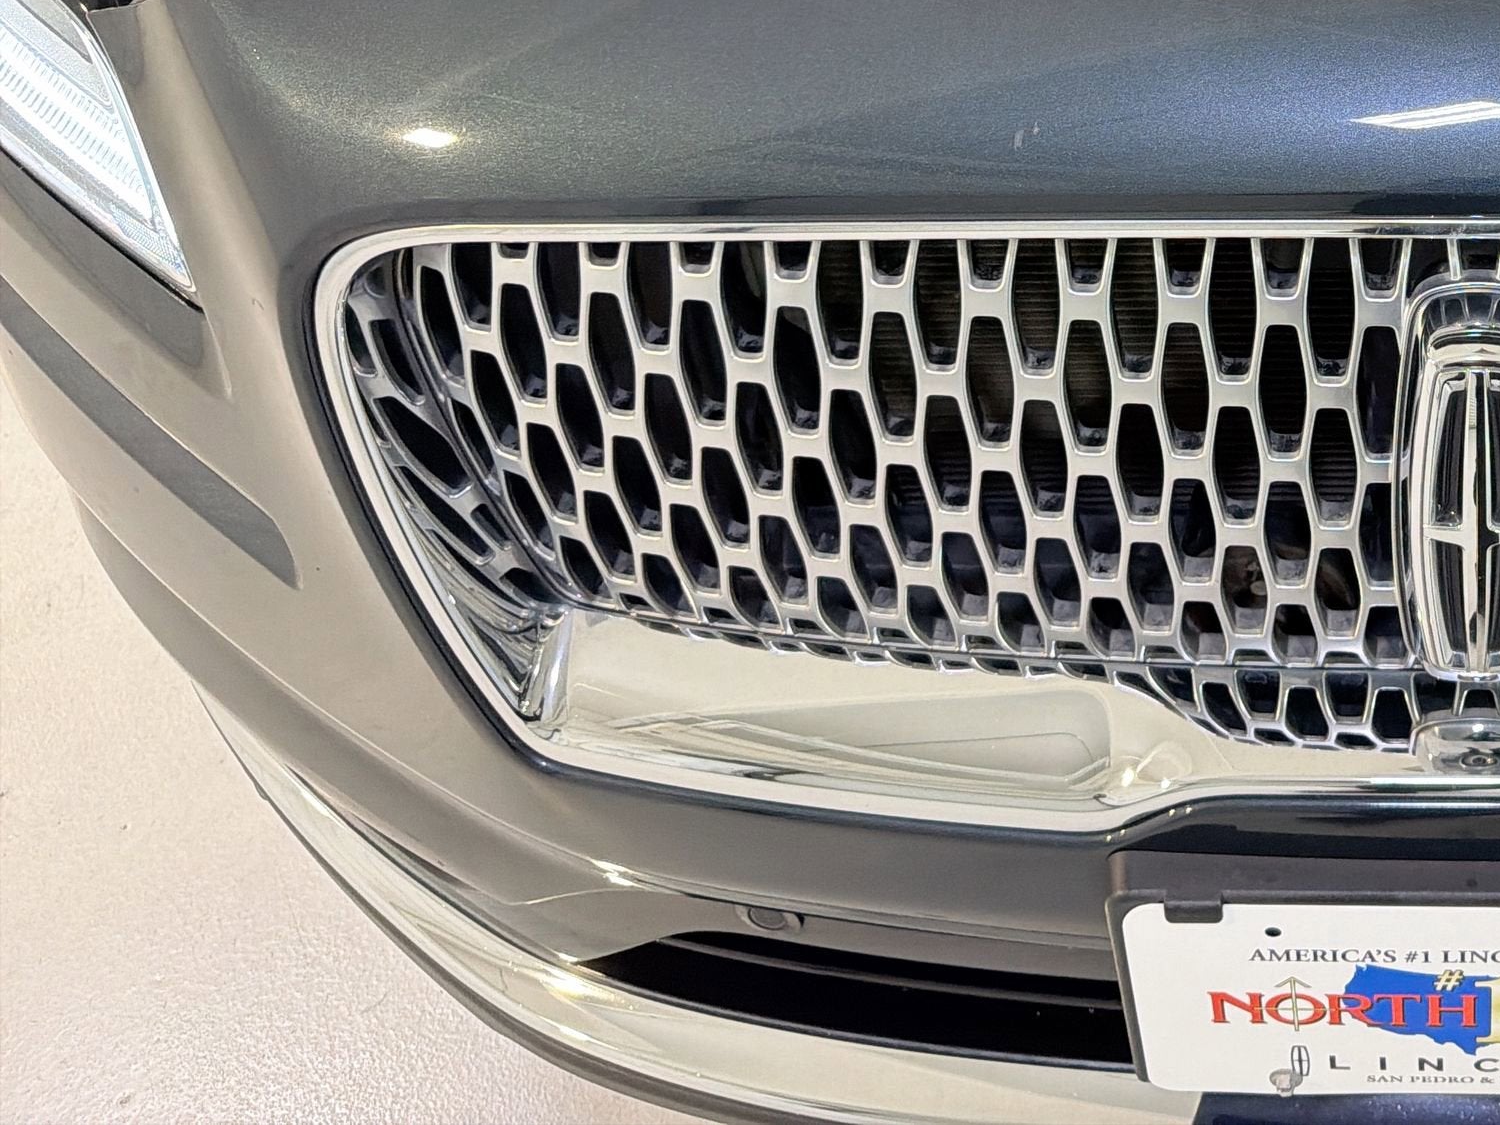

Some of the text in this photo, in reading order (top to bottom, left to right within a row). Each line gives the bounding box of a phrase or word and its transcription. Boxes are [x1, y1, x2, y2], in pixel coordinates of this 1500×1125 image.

[1249, 948, 1397, 963] AMERICA'S
[1404, 950, 1432, 964] #1
[1207, 991, 1479, 1028] NORTH
[1366, 1074, 1403, 1084] SAN
[1409, 1075, 1475, 1085] PEDRO
[1479, 1076, 1495, 1085] &
